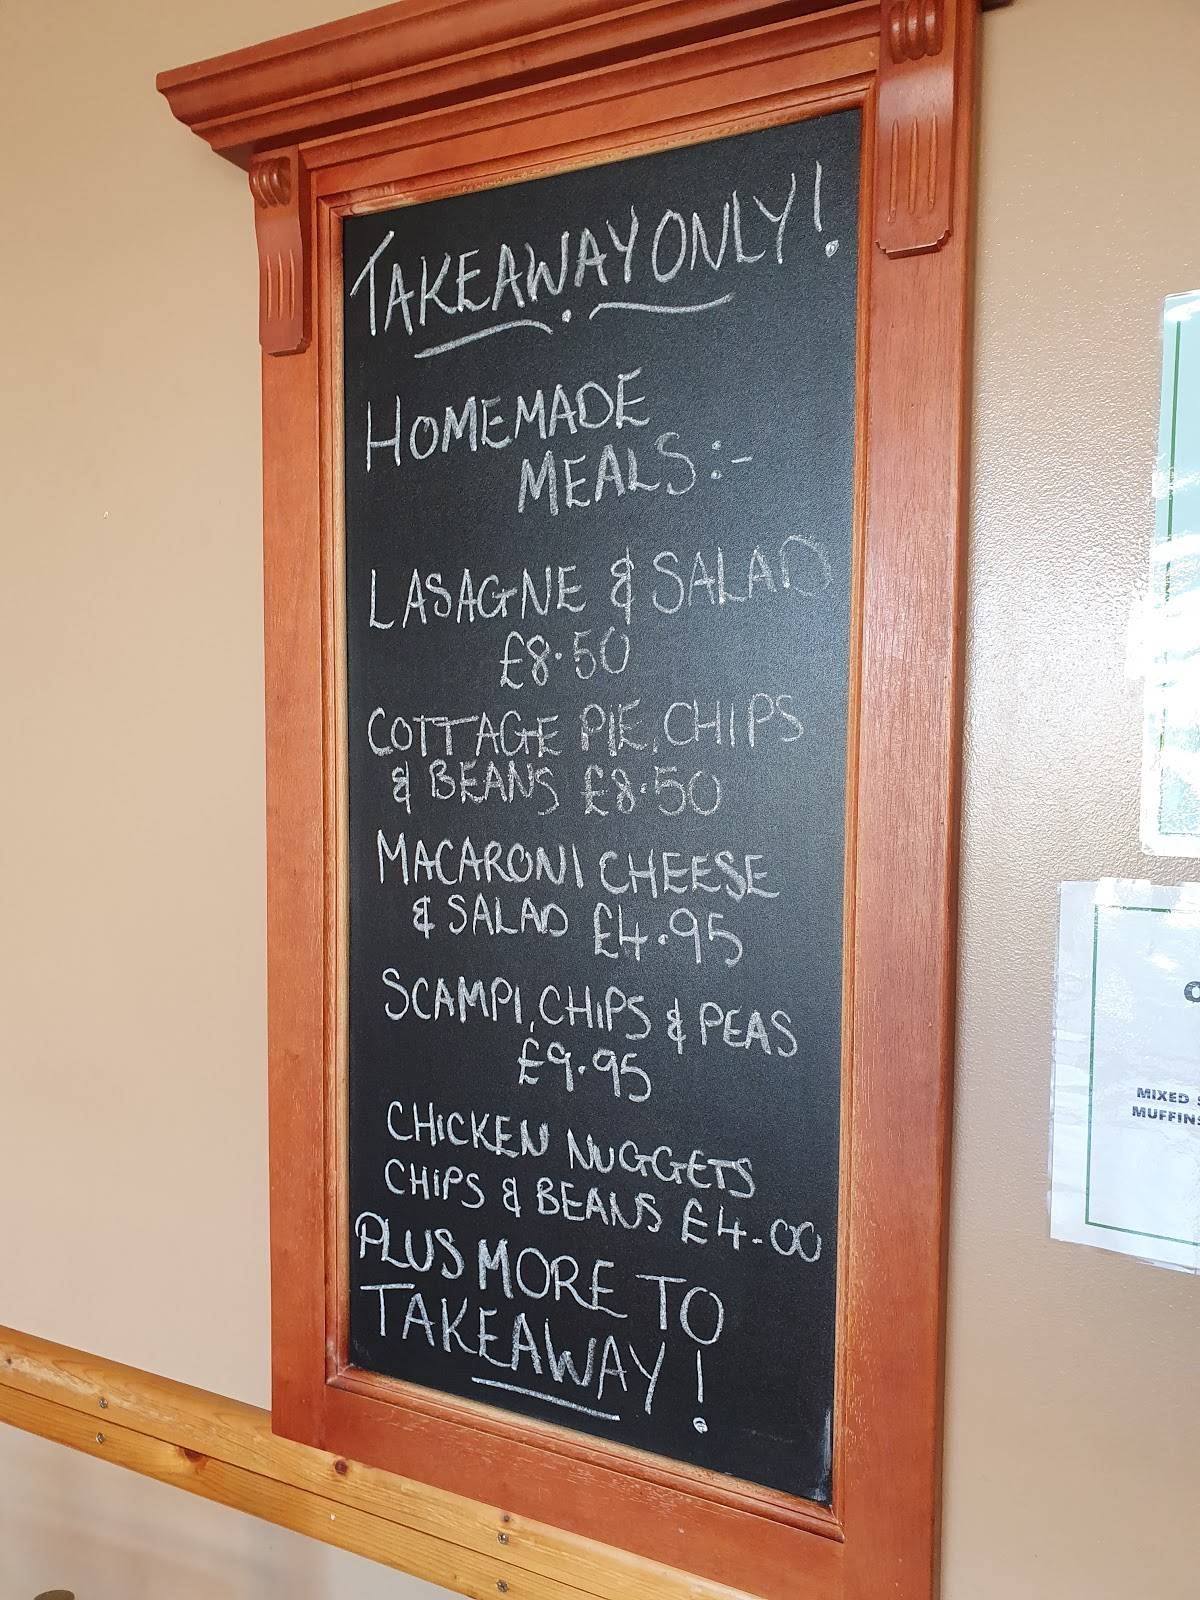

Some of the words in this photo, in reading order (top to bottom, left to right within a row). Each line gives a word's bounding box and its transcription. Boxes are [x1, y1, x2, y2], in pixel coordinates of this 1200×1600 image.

[350, 206, 638, 335] TAKEAWAY
[652, 160, 840, 283] ONLY!
[366, 368, 650, 472] HOMEMADE
[368, 565, 587, 630] LASAGNE
[610, 548, 634, 625] &
[652, 535, 832, 614] SALAD
[368, 707, 562, 758] COTTAGE
[664, 693, 804, 747] CHIPS
[392, 760, 411, 815] &
[429, 760, 560, 816] BEANS
[376, 830, 584, 890] MACARONI
[600, 849, 780, 901] CHEESE
[412, 896, 435, 939] &
[448, 893, 569, 937] SALAD
[538, 984, 652, 1041] CHIPS
[667, 998, 685, 1055] &
[699, 1001, 799, 1058] PEAS
[1136, 1087, 1190, 1104] MIXED
[386, 1100, 550, 1158] CHICKEN
[567, 1129, 757, 1199] NUGGETS
[383, 1158, 486, 1209] CHIPS
[502, 1177, 521, 1218] &
[536, 1176, 663, 1233] BEANS
[355, 1211, 466, 1281] PLUS
[478, 1238, 628, 1319] MORE
[635, 1274, 725, 1346] TO
